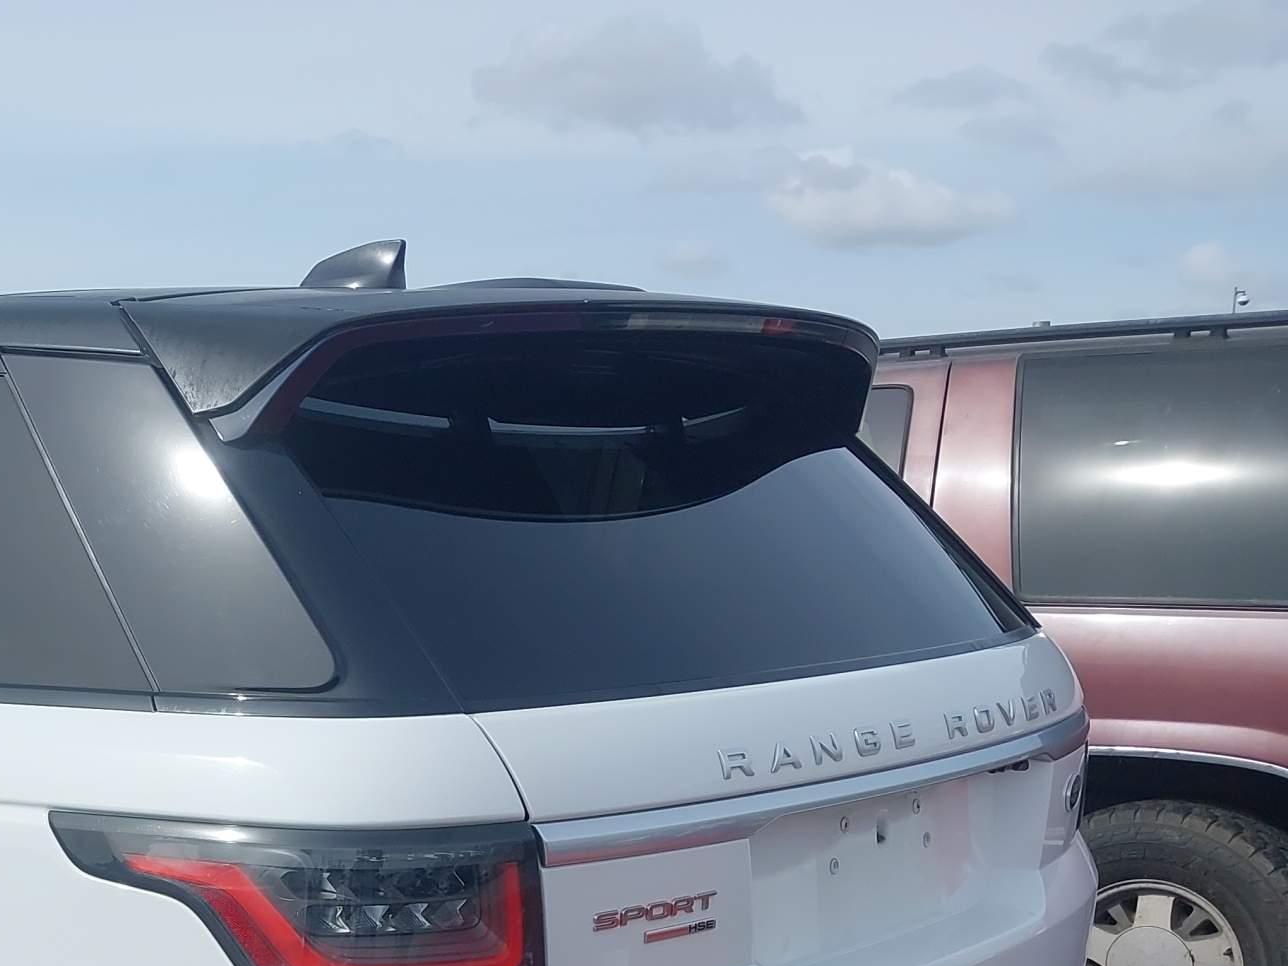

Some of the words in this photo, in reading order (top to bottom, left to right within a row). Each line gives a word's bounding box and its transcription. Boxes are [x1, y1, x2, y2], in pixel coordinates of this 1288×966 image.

[716, 719, 916, 781] RANGE
[943, 687, 1058, 741] ROVER
[592, 889, 718, 933] SPORT
[688, 918, 717, 936] HSE
